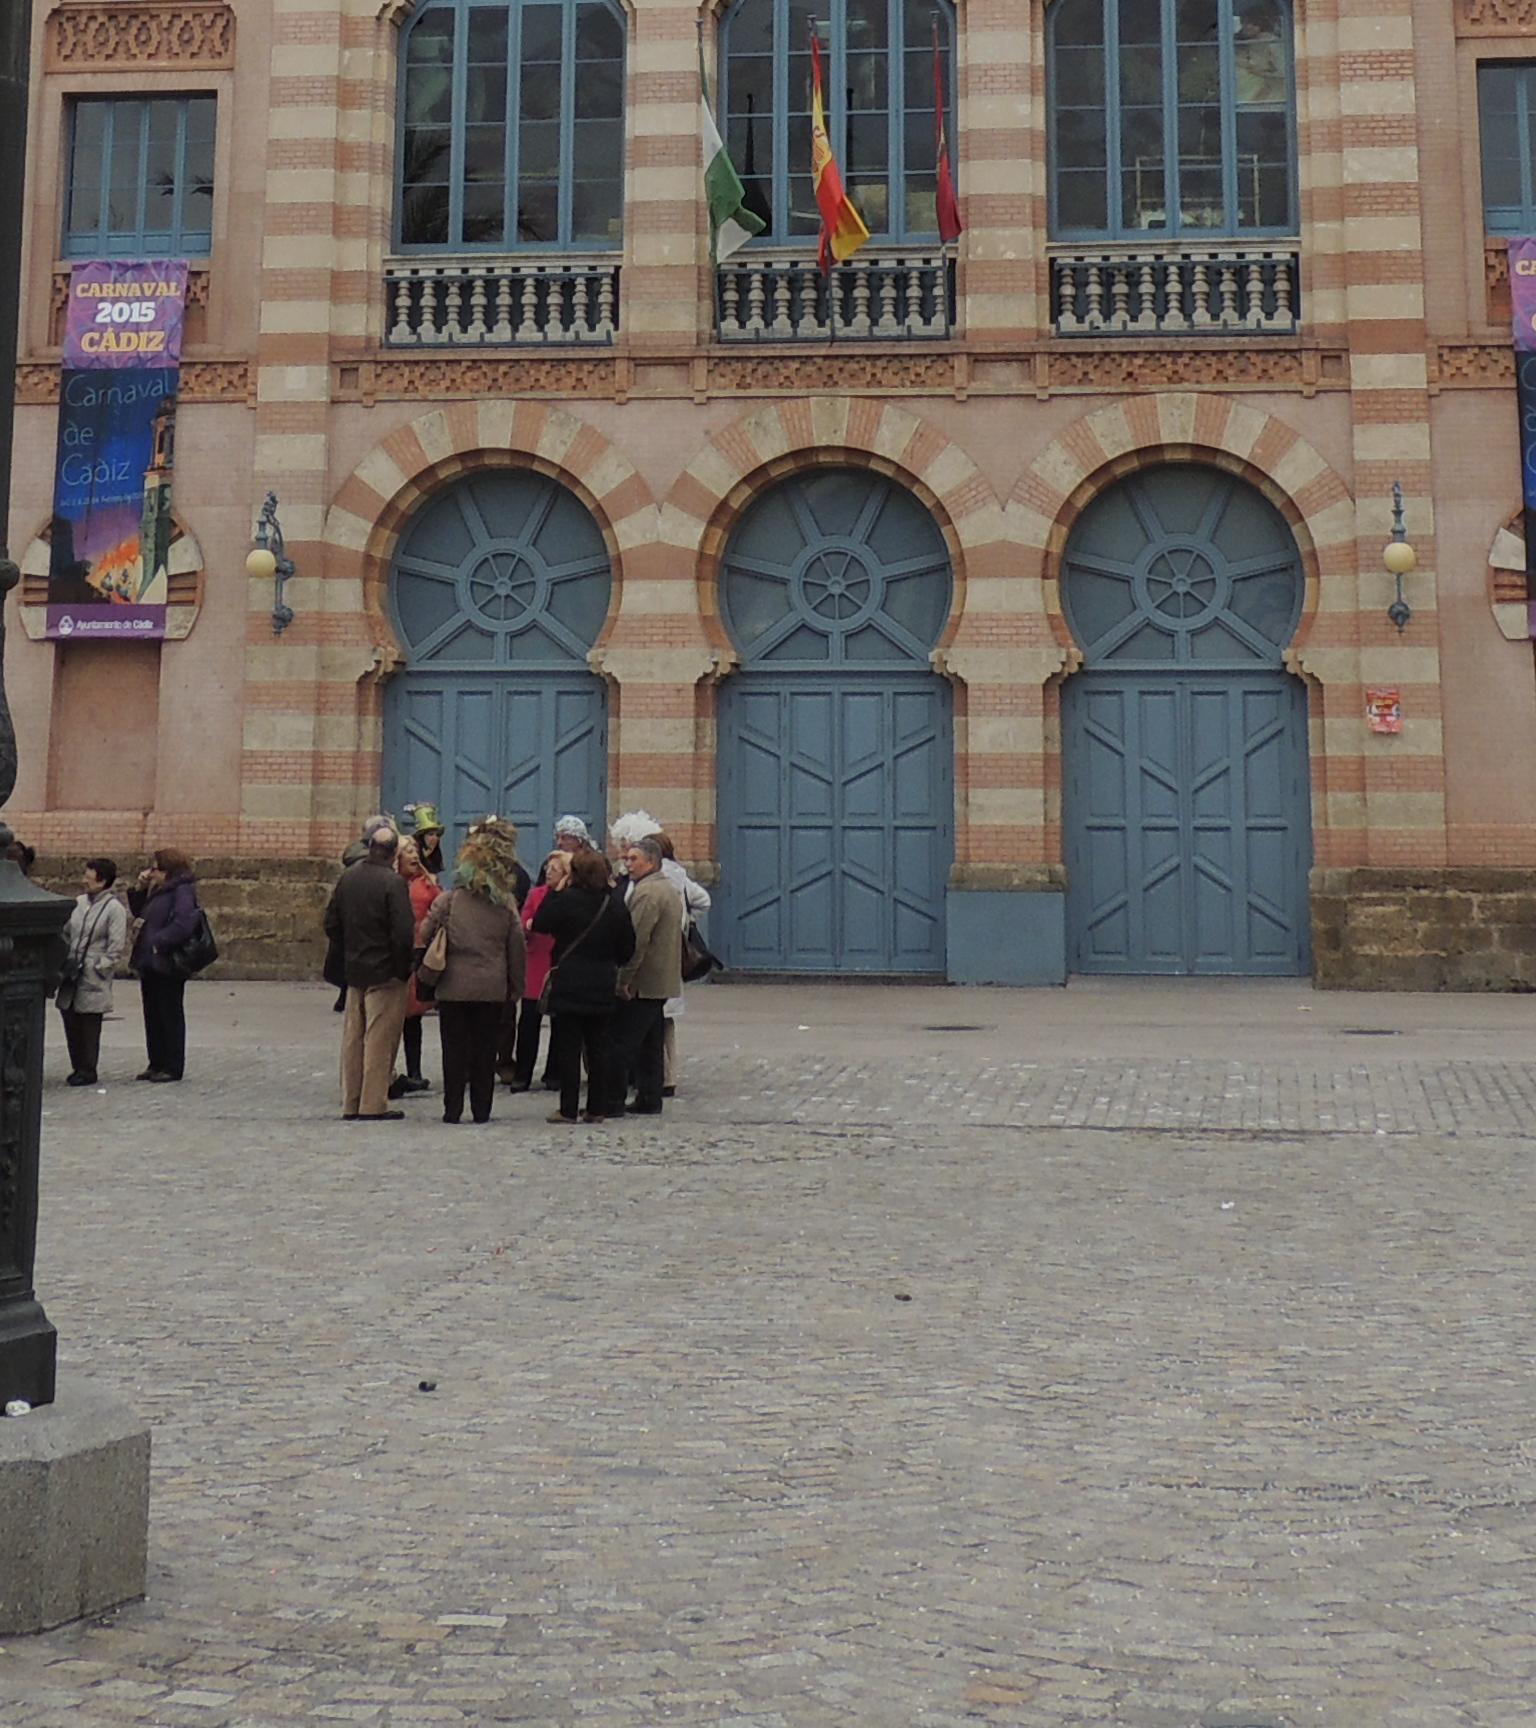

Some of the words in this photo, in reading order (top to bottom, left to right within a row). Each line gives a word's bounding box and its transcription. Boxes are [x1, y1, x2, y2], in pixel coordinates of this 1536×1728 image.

[75, 282, 181, 298] CARNAVAL
[94, 301, 156, 323] 2015
[80, 326, 165, 353] CÁDIZ
[65, 369, 170, 406] Carnaval
[63, 420, 94, 446] de
